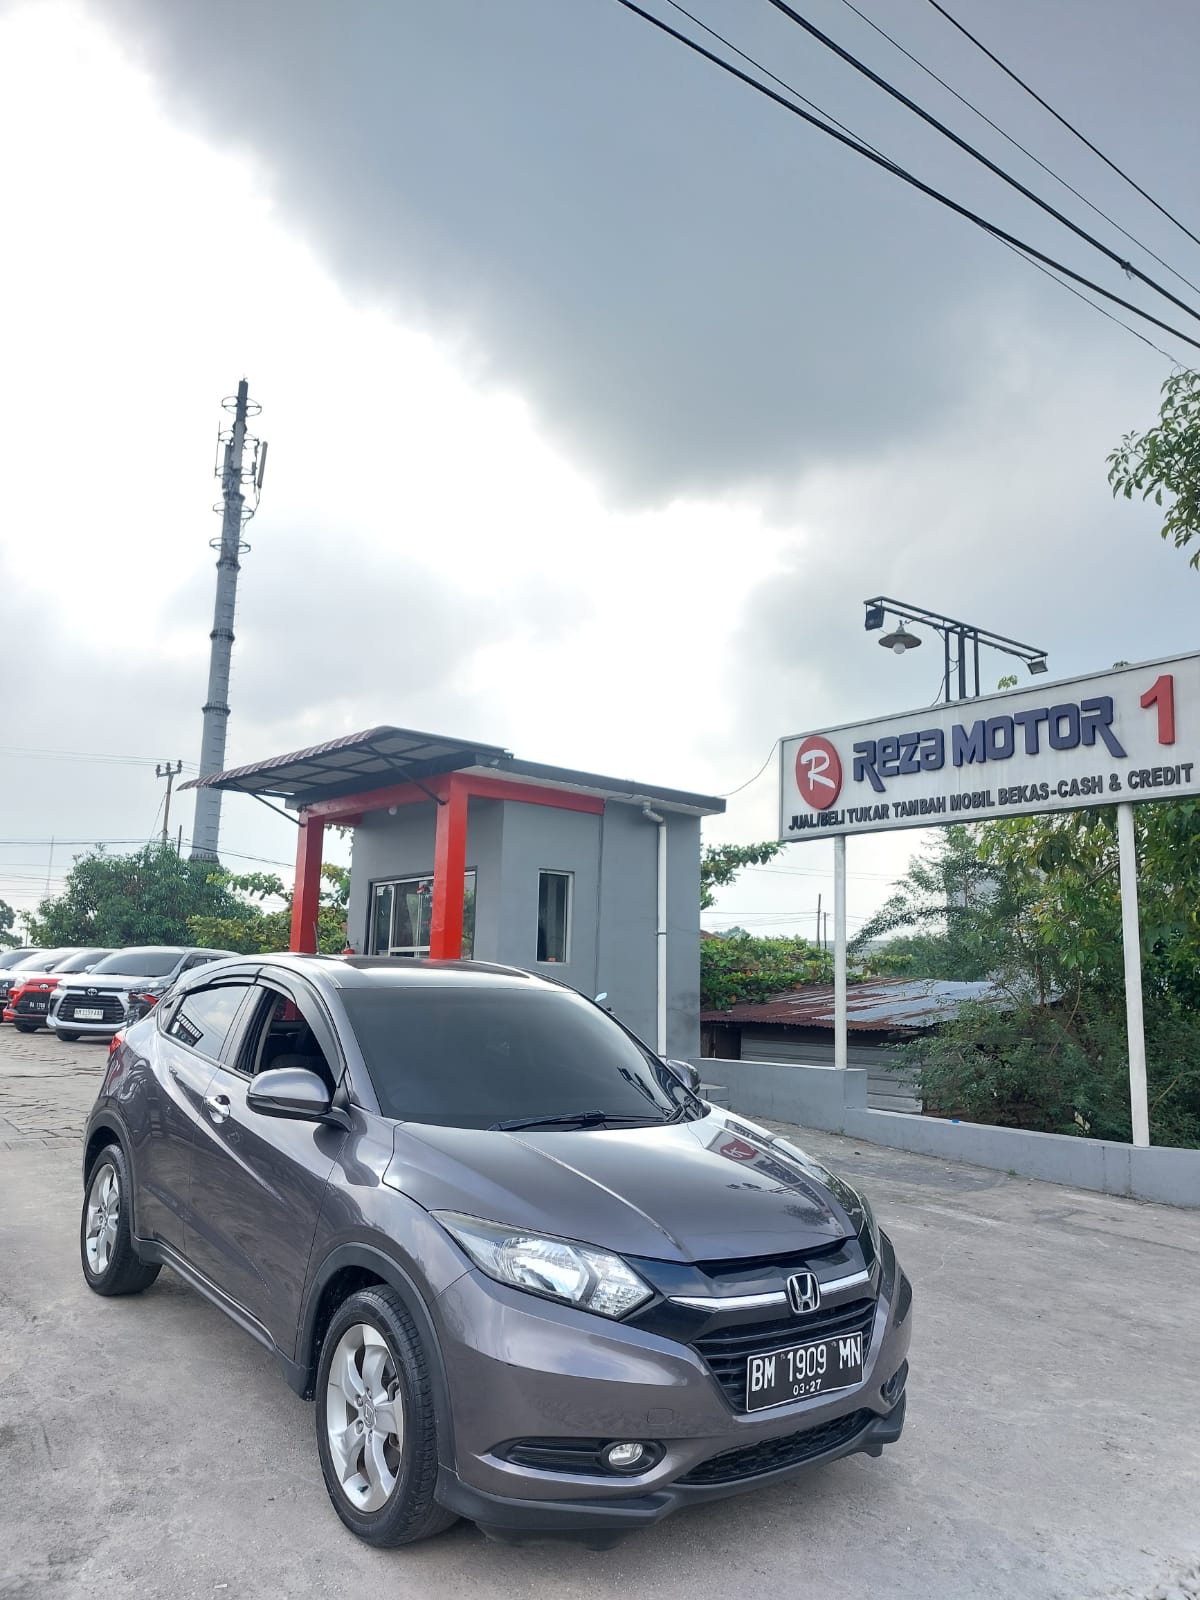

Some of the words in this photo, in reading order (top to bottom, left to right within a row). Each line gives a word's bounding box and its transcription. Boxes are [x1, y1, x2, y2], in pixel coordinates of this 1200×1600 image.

[952, 696, 1128, 767] MOTOR
[1140, 674, 1175, 745] 1
[789, 809, 845, 830] JUAL/BELI
[847, 804, 889, 823] TUKAR
[893, 796, 946, 818] TAMBAH
[950, 789, 995, 811] MOBIL
[998, 775, 1103, 805] BEKAS-CASH
[1109, 773, 1122, 792] &
[1127, 763, 1194, 789] CREDIT
[800, 749, 836, 791] R
[751, 1356, 776, 1392] BM
[787, 1344, 827, 1382] 1909
[839, 1336, 861, 1369] MN
